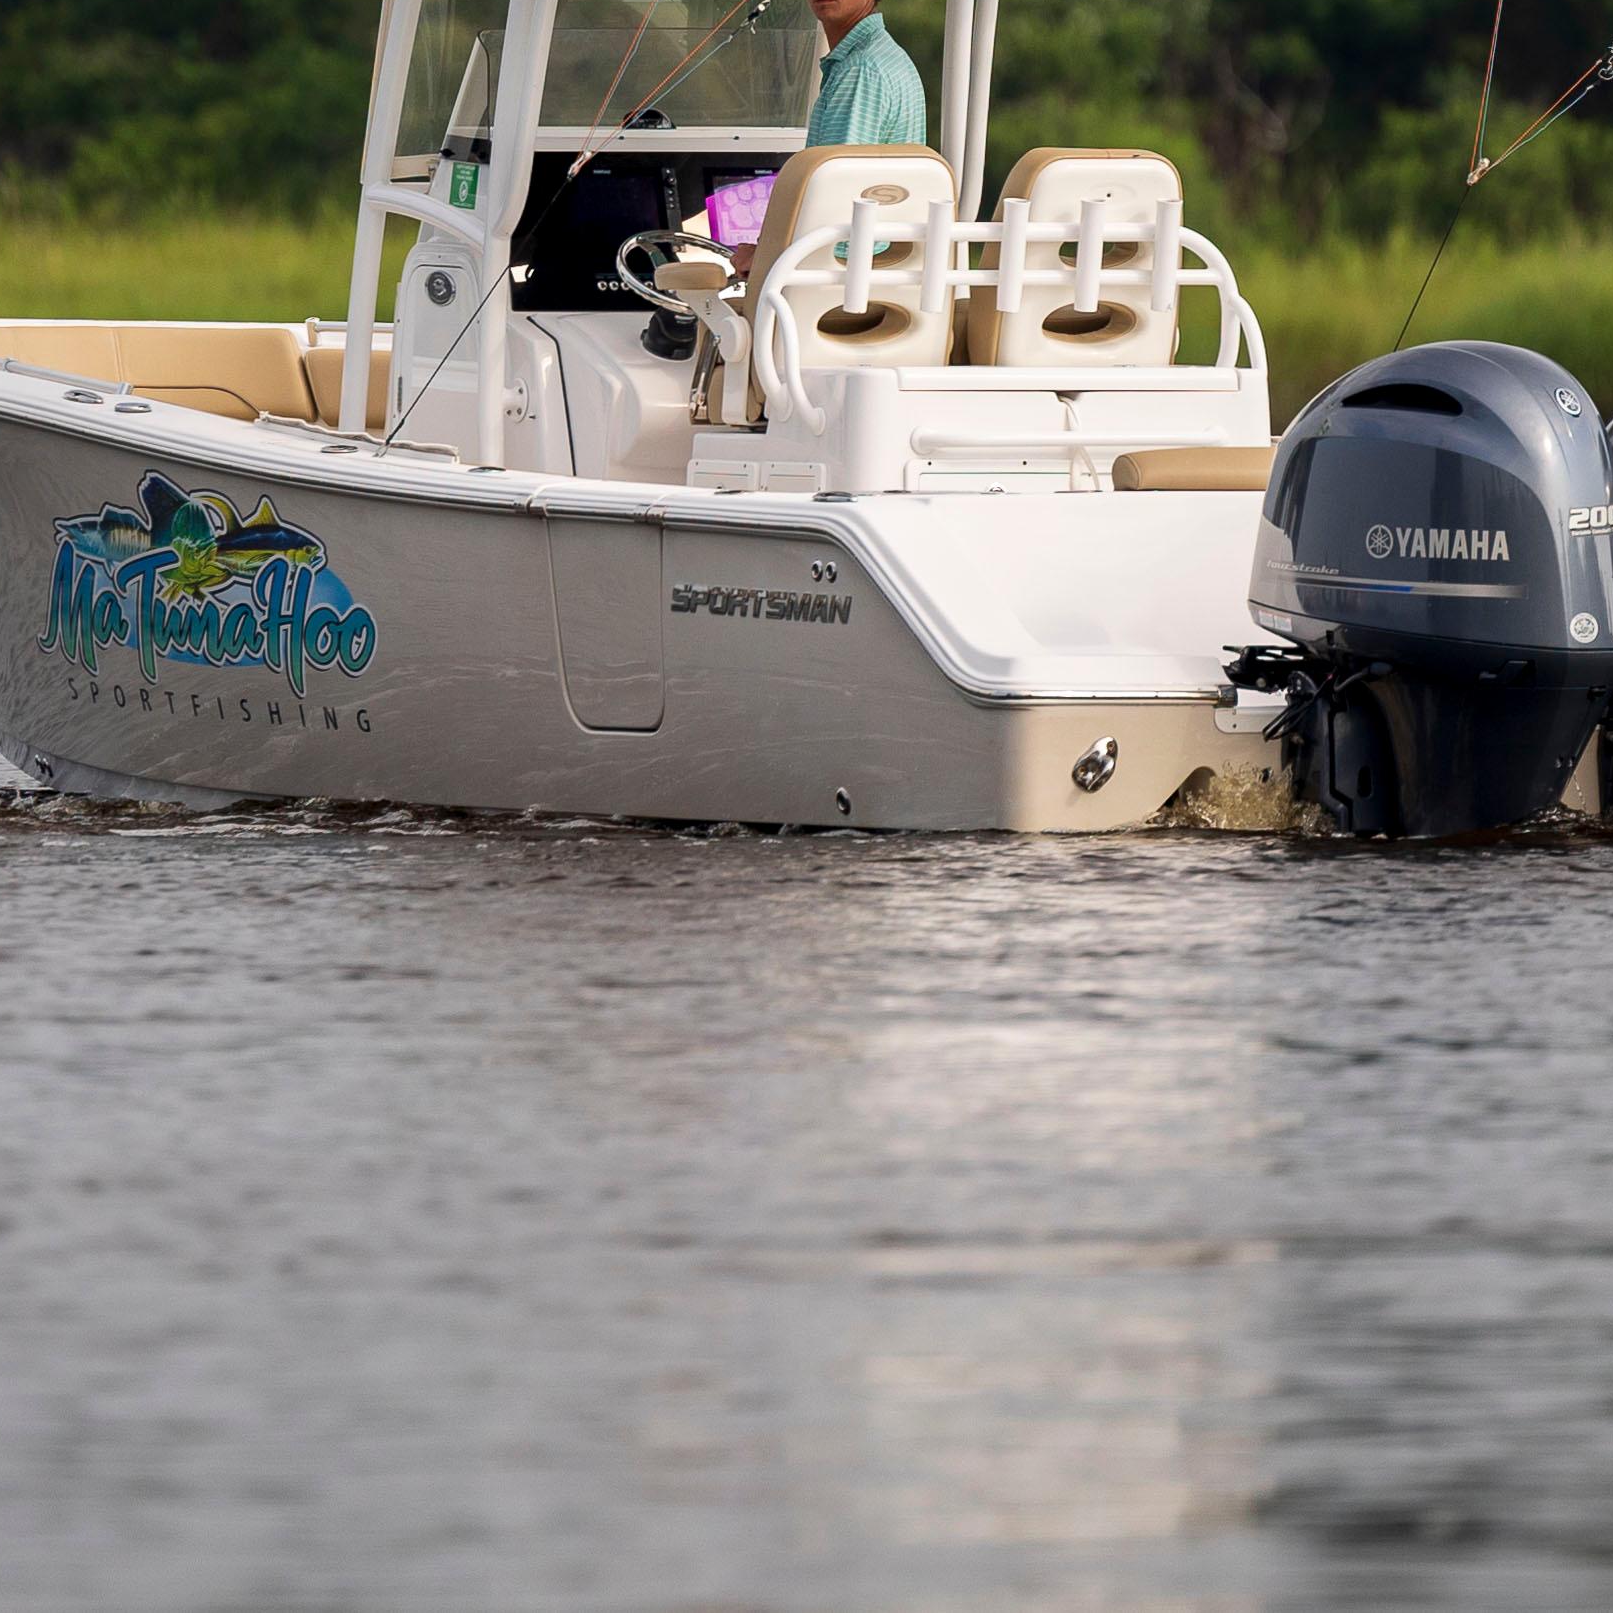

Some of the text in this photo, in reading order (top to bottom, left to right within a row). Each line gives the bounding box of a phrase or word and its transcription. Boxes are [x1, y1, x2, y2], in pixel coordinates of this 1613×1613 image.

[1396, 527, 1510, 561] YAMAHA
[671, 584, 852, 624] SPORTSMAN
[68, 678, 372, 733] SPORTFISHING
